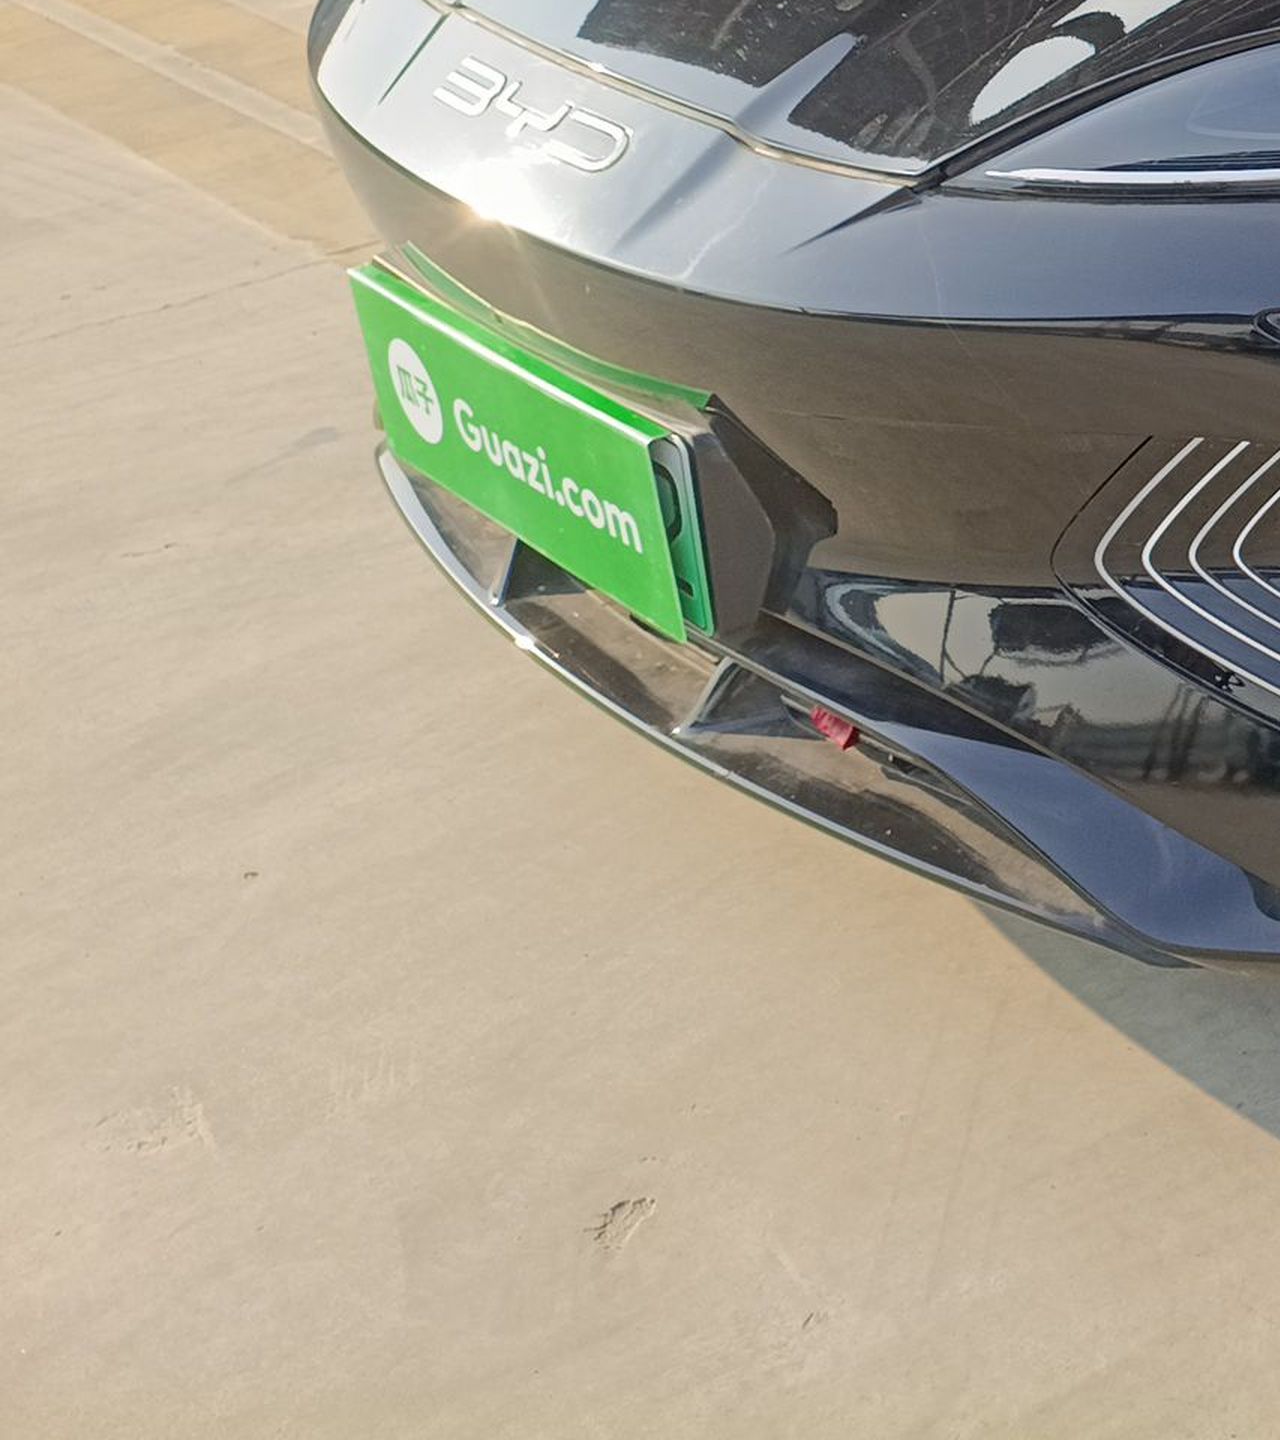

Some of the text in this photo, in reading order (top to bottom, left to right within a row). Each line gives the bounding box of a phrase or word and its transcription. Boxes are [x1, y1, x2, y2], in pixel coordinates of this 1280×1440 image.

[432, 55, 633, 174] BYD
[396, 363, 433, 415] 瓜子
[453, 398, 643, 554] Guazi.com
